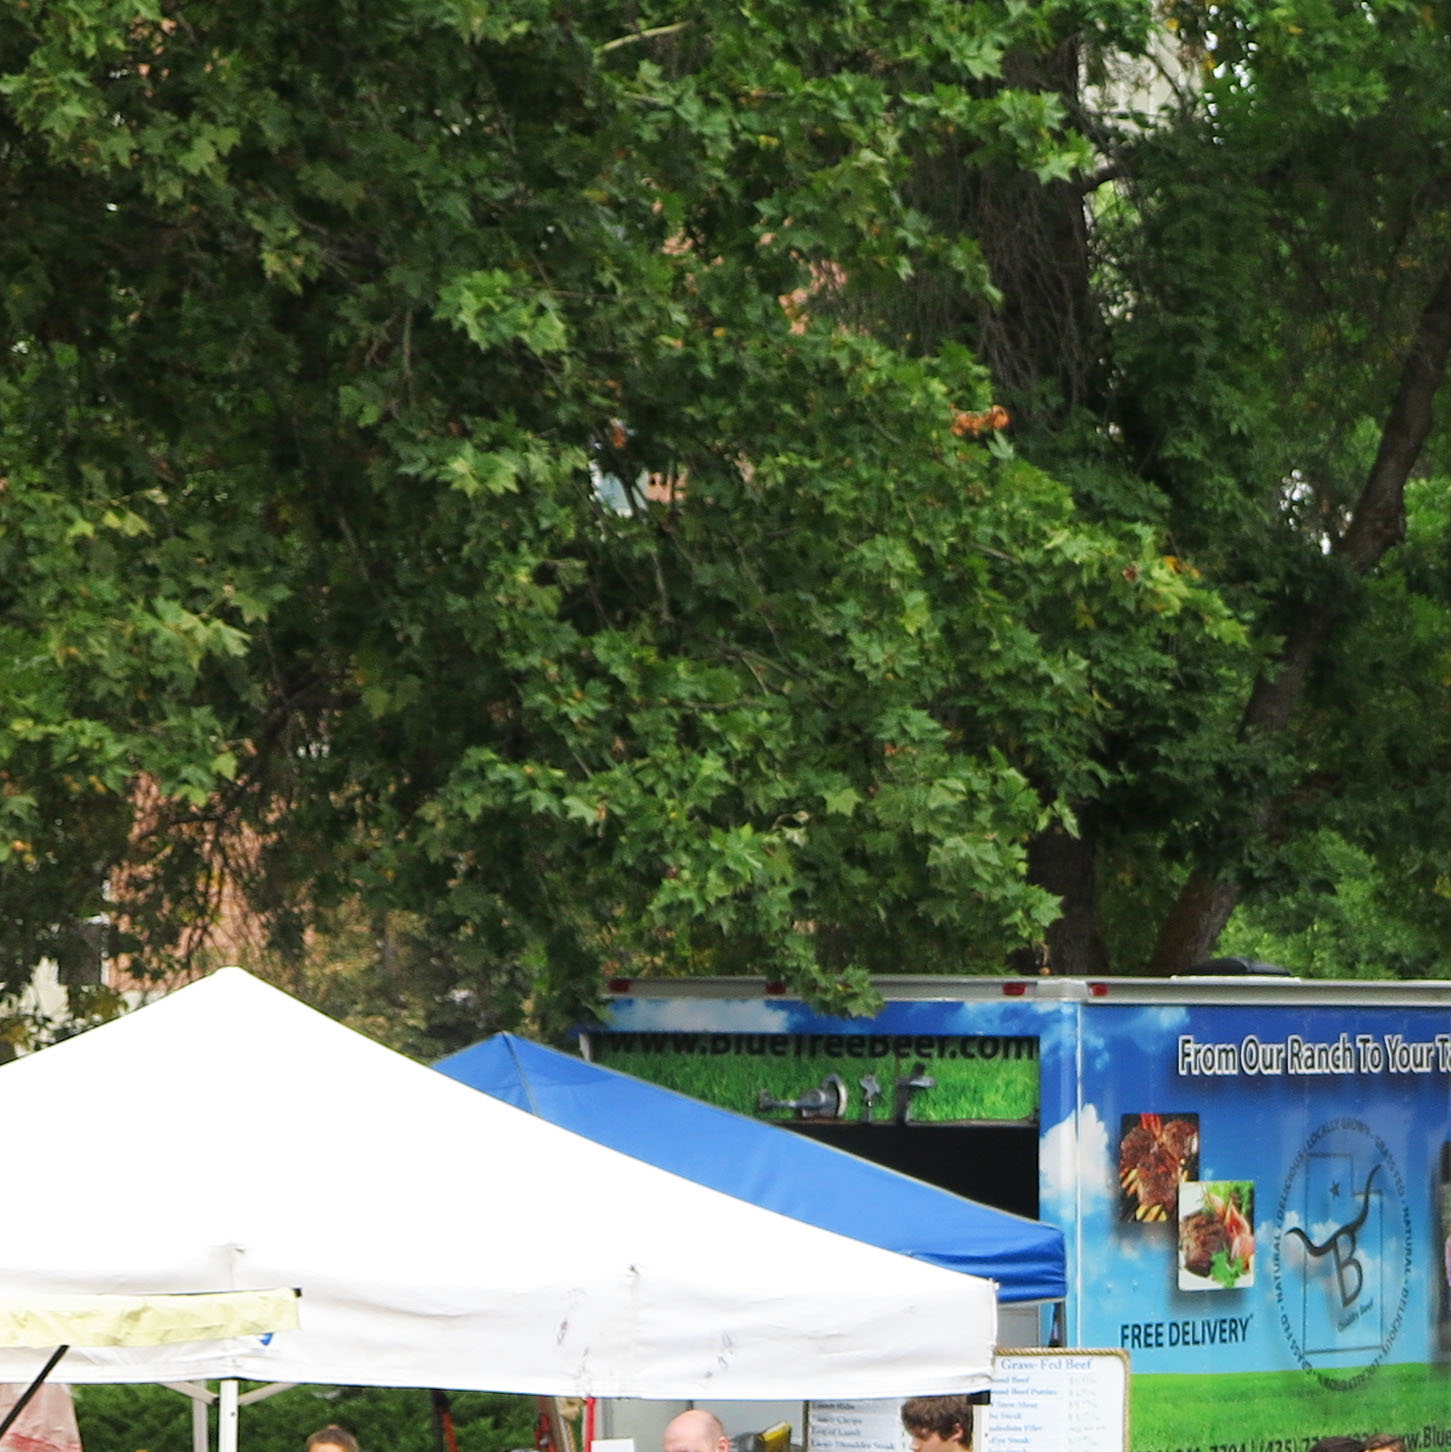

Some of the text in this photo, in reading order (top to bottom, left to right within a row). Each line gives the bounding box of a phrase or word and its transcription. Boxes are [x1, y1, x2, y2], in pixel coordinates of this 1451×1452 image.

[1178, 1035, 1238, 1075] From
[1241, 1035, 1285, 1074] Our
[1287, 1032, 1354, 1074] Ranch
[1356, 1034, 1383, 1072] To
[1385, 1034, 1434, 1072] Your
[1121, 1323, 1164, 1348] FREE
[1066, 1358, 1092, 1370] Beef
